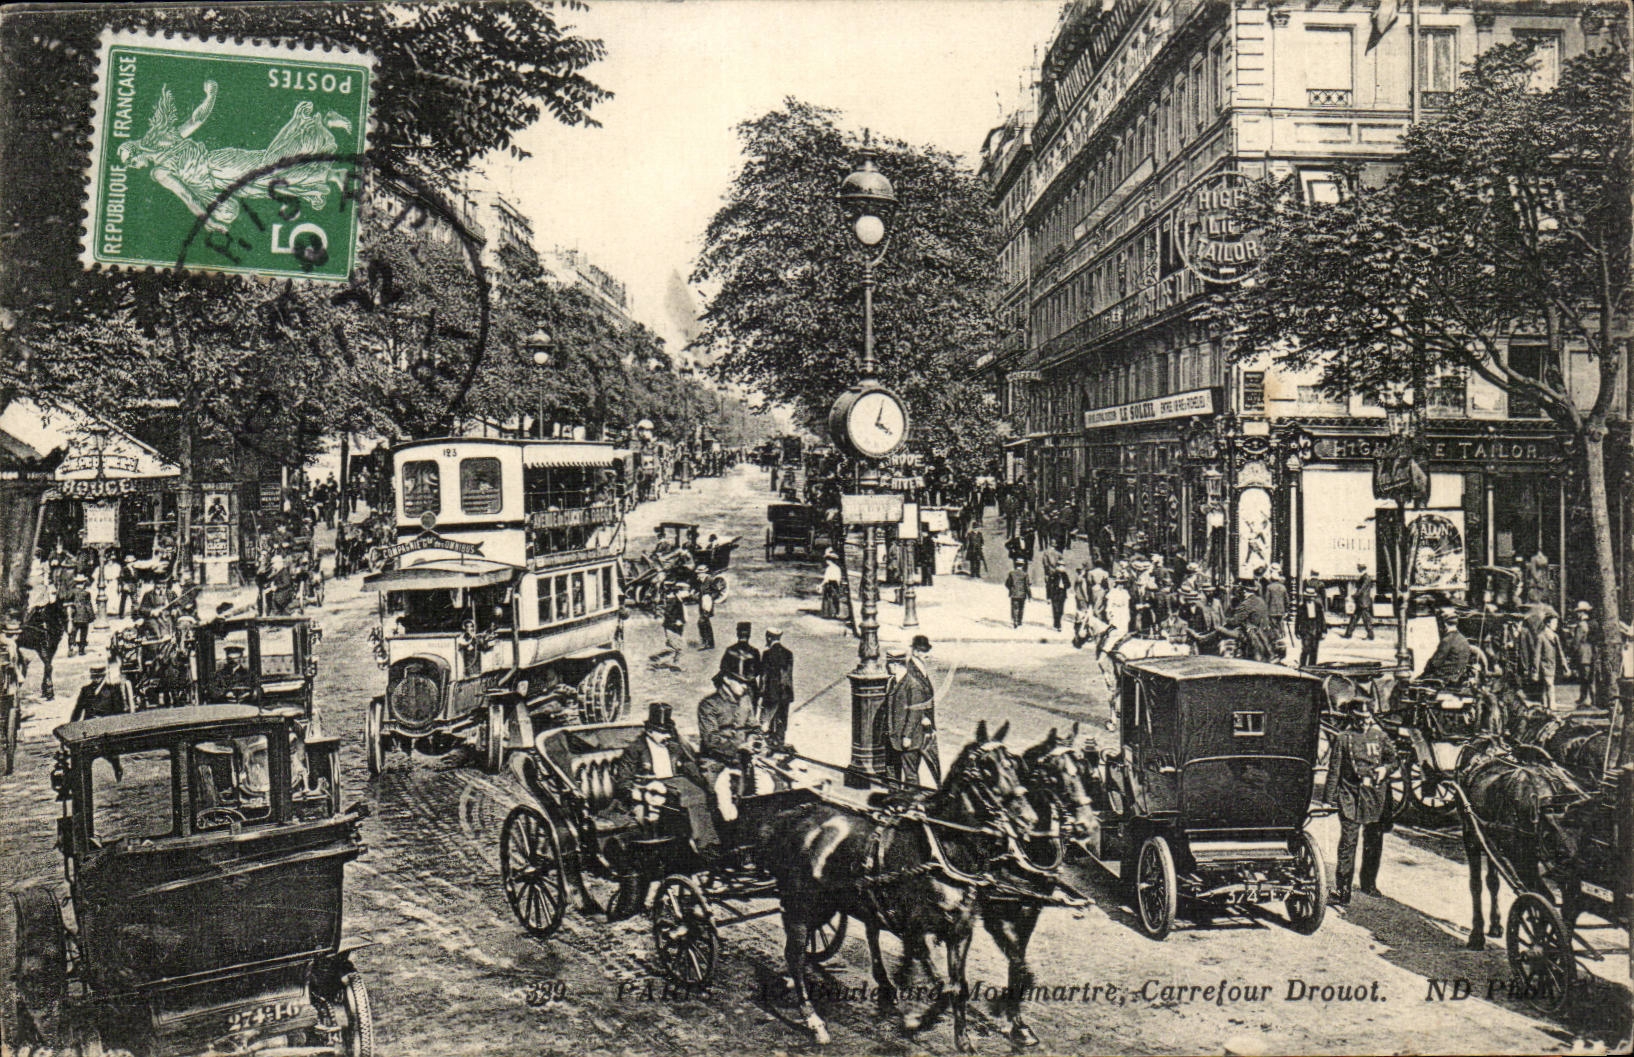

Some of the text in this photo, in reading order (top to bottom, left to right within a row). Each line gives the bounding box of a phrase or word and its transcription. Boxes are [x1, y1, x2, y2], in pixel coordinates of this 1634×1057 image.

[268, 68, 352, 94] POSTES
[103, 55, 137, 254] REPUBLIQUE FRANÇAISE
[271, 222, 328, 255] 5
[1198, 238, 1259, 261] TAILOR
[1459, 442, 1537, 459] TAILOR
[382, 540, 421, 559] COMPAGNIE
[445, 540, 475, 554] OMNIBUS
